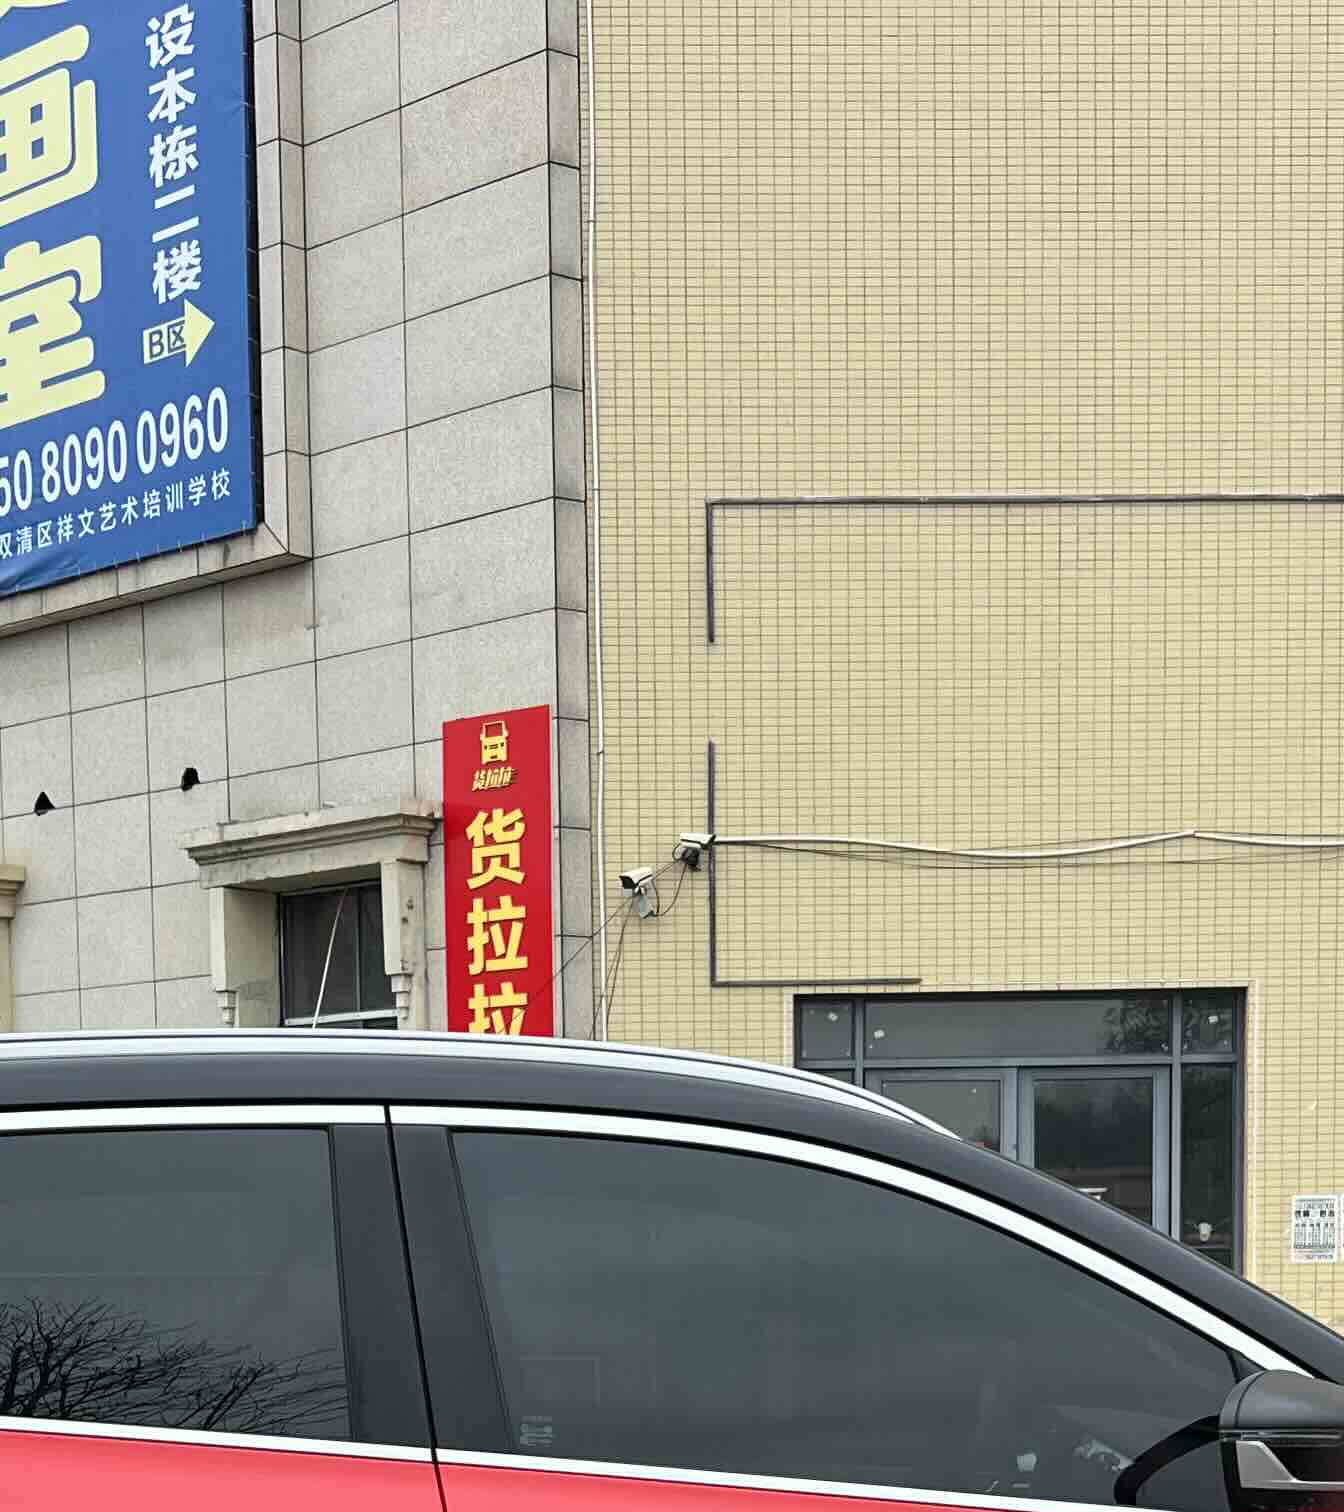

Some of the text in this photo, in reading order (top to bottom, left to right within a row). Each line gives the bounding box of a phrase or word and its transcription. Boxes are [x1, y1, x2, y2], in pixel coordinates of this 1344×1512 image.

[144, 3, 202, 304] 设本栋二楼
[148, 318, 186, 362] B区
[40, 420, 128, 503] 8090
[136, 386, 229, 475] 0960
[466, 808, 529, 1038] 货拉拉
